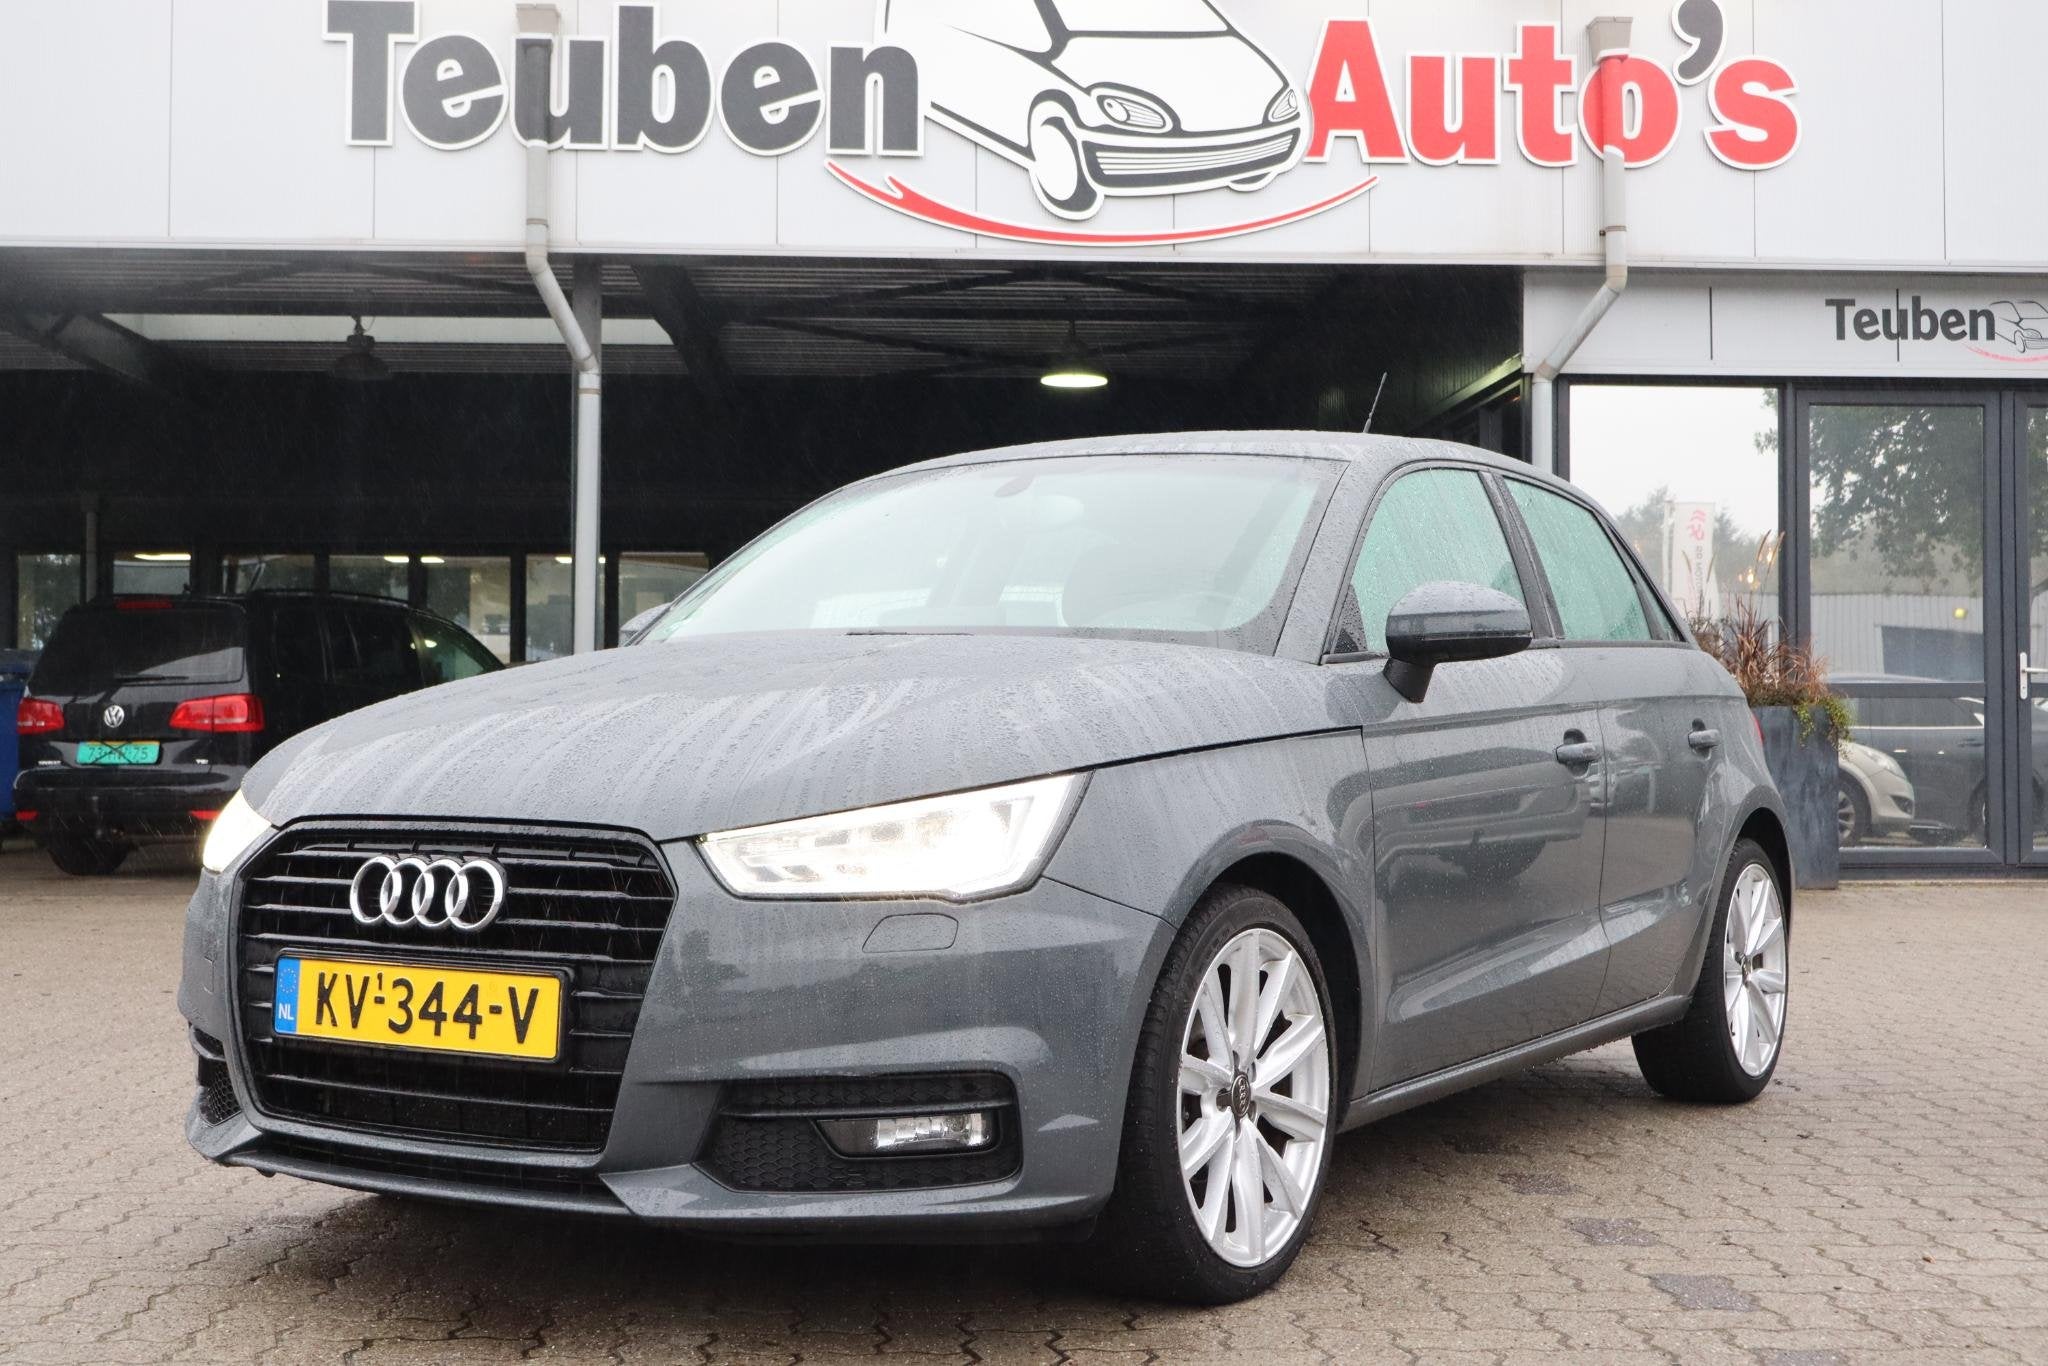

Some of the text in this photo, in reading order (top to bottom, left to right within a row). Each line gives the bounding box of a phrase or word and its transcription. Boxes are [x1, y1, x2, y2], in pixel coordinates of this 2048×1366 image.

[324, 0, 1800, 169] Teuben Auto's
[1825, 295, 1996, 341] Teuben
[278, 1003, 294, 1020] NL
